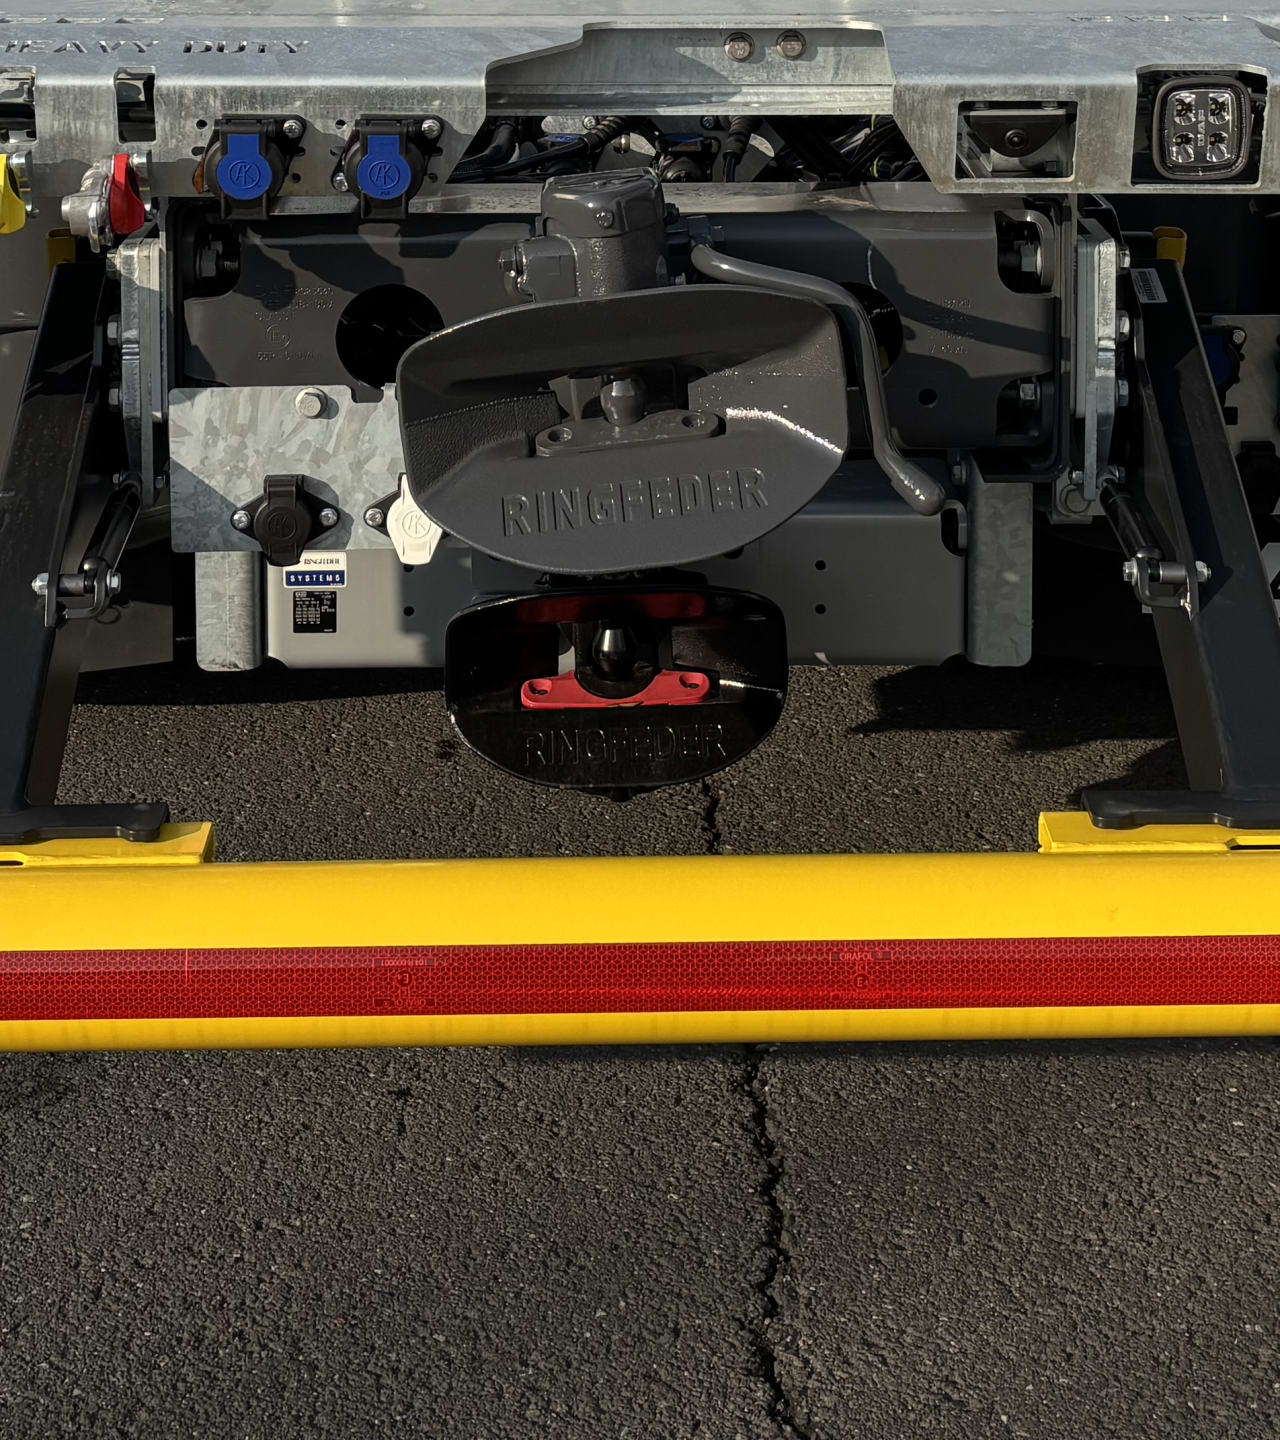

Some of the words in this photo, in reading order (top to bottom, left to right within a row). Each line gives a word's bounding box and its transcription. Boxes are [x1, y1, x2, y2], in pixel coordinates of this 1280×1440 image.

[182, 39, 312, 54] DUTY
[501, 466, 769, 537] RINGFEDER
[290, 574, 341, 583] SYSTEMS
[523, 723, 727, 767] RINGFEDER
